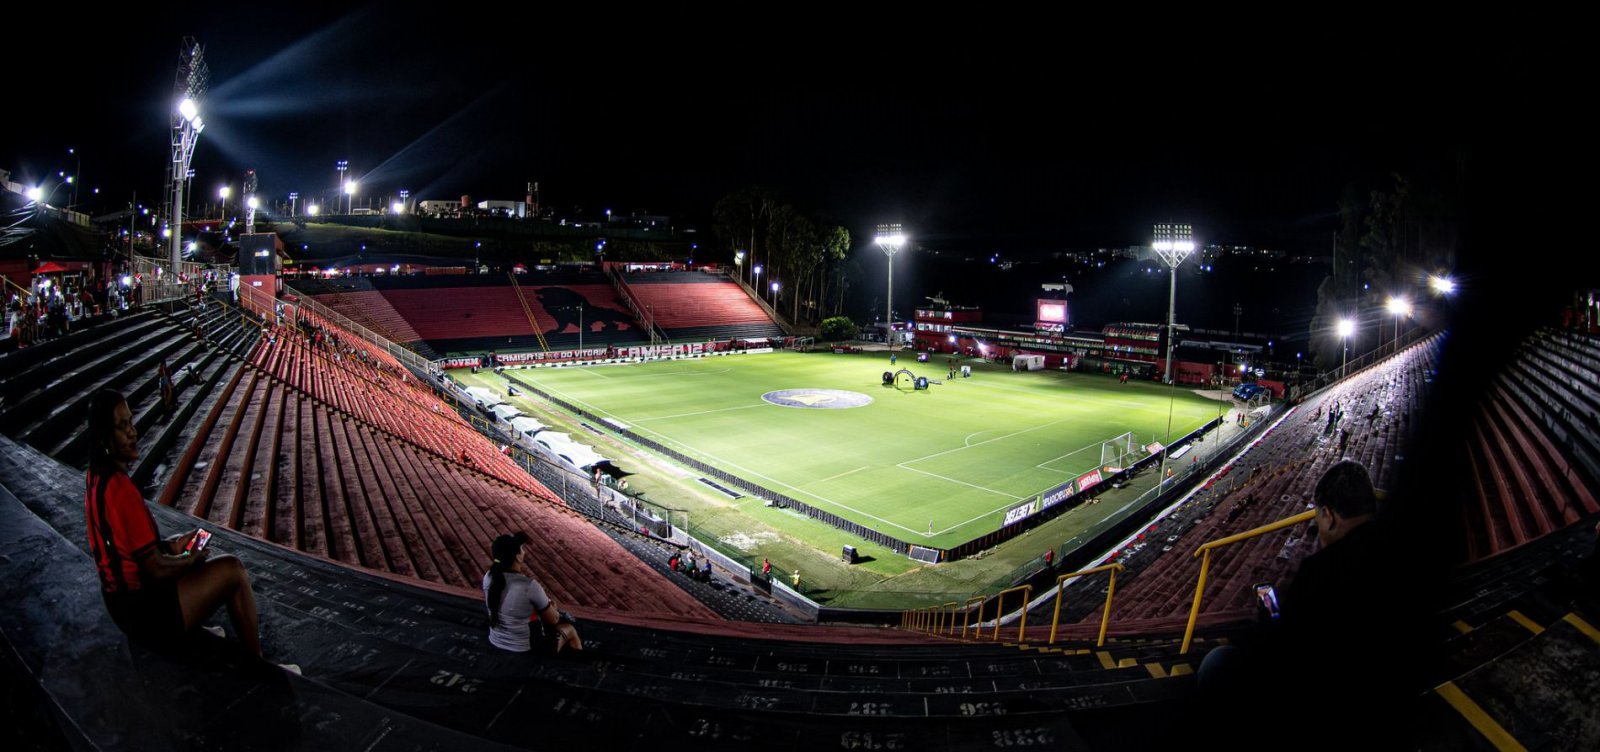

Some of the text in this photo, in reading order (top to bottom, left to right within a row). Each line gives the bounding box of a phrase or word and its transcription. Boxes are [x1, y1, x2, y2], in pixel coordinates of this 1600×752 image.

[617, 343, 703, 357] CAMISA 12
[447, 357, 479, 367] JOVEM
[496, 352, 534, 362] CAMISA
